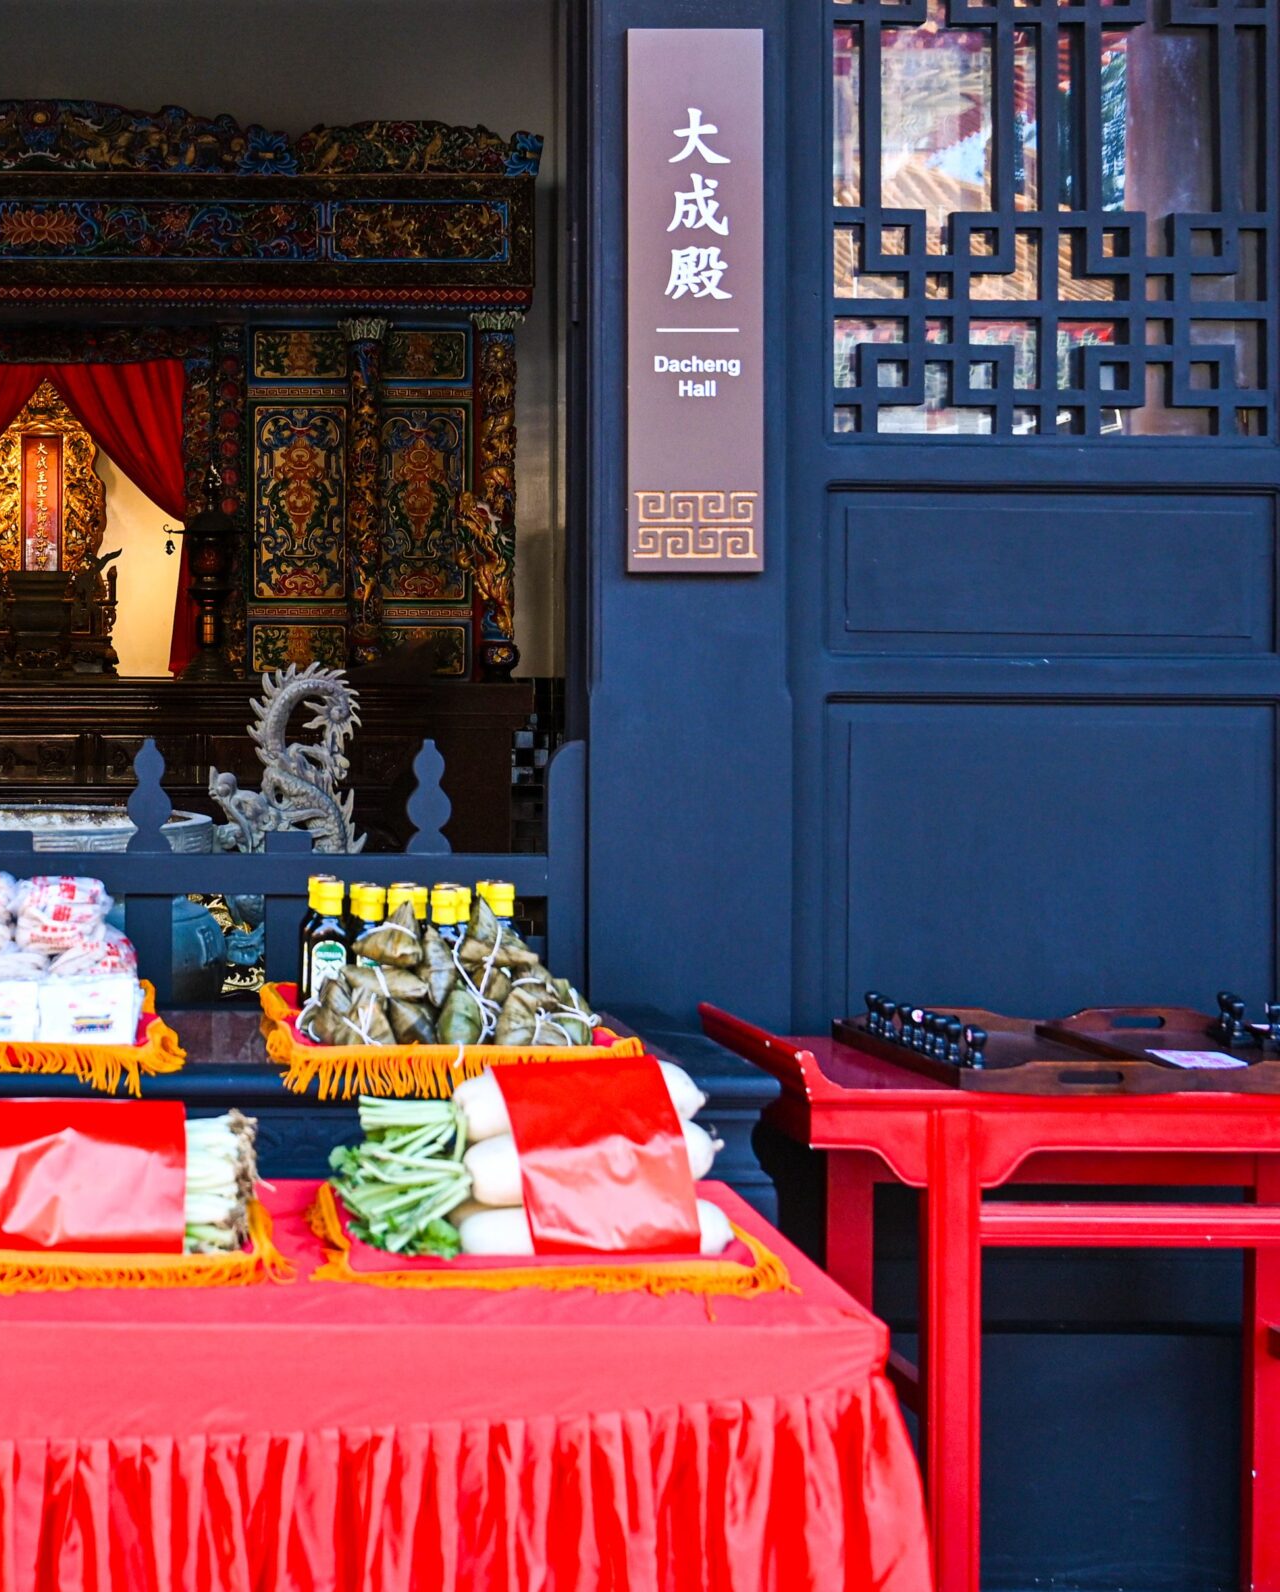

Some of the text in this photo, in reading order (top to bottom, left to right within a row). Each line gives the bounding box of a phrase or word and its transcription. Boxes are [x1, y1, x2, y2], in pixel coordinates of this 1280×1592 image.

[664, 108, 733, 299] 大成殿
[654, 355, 740, 377] Dacheng
[678, 380, 717, 397] Hall
